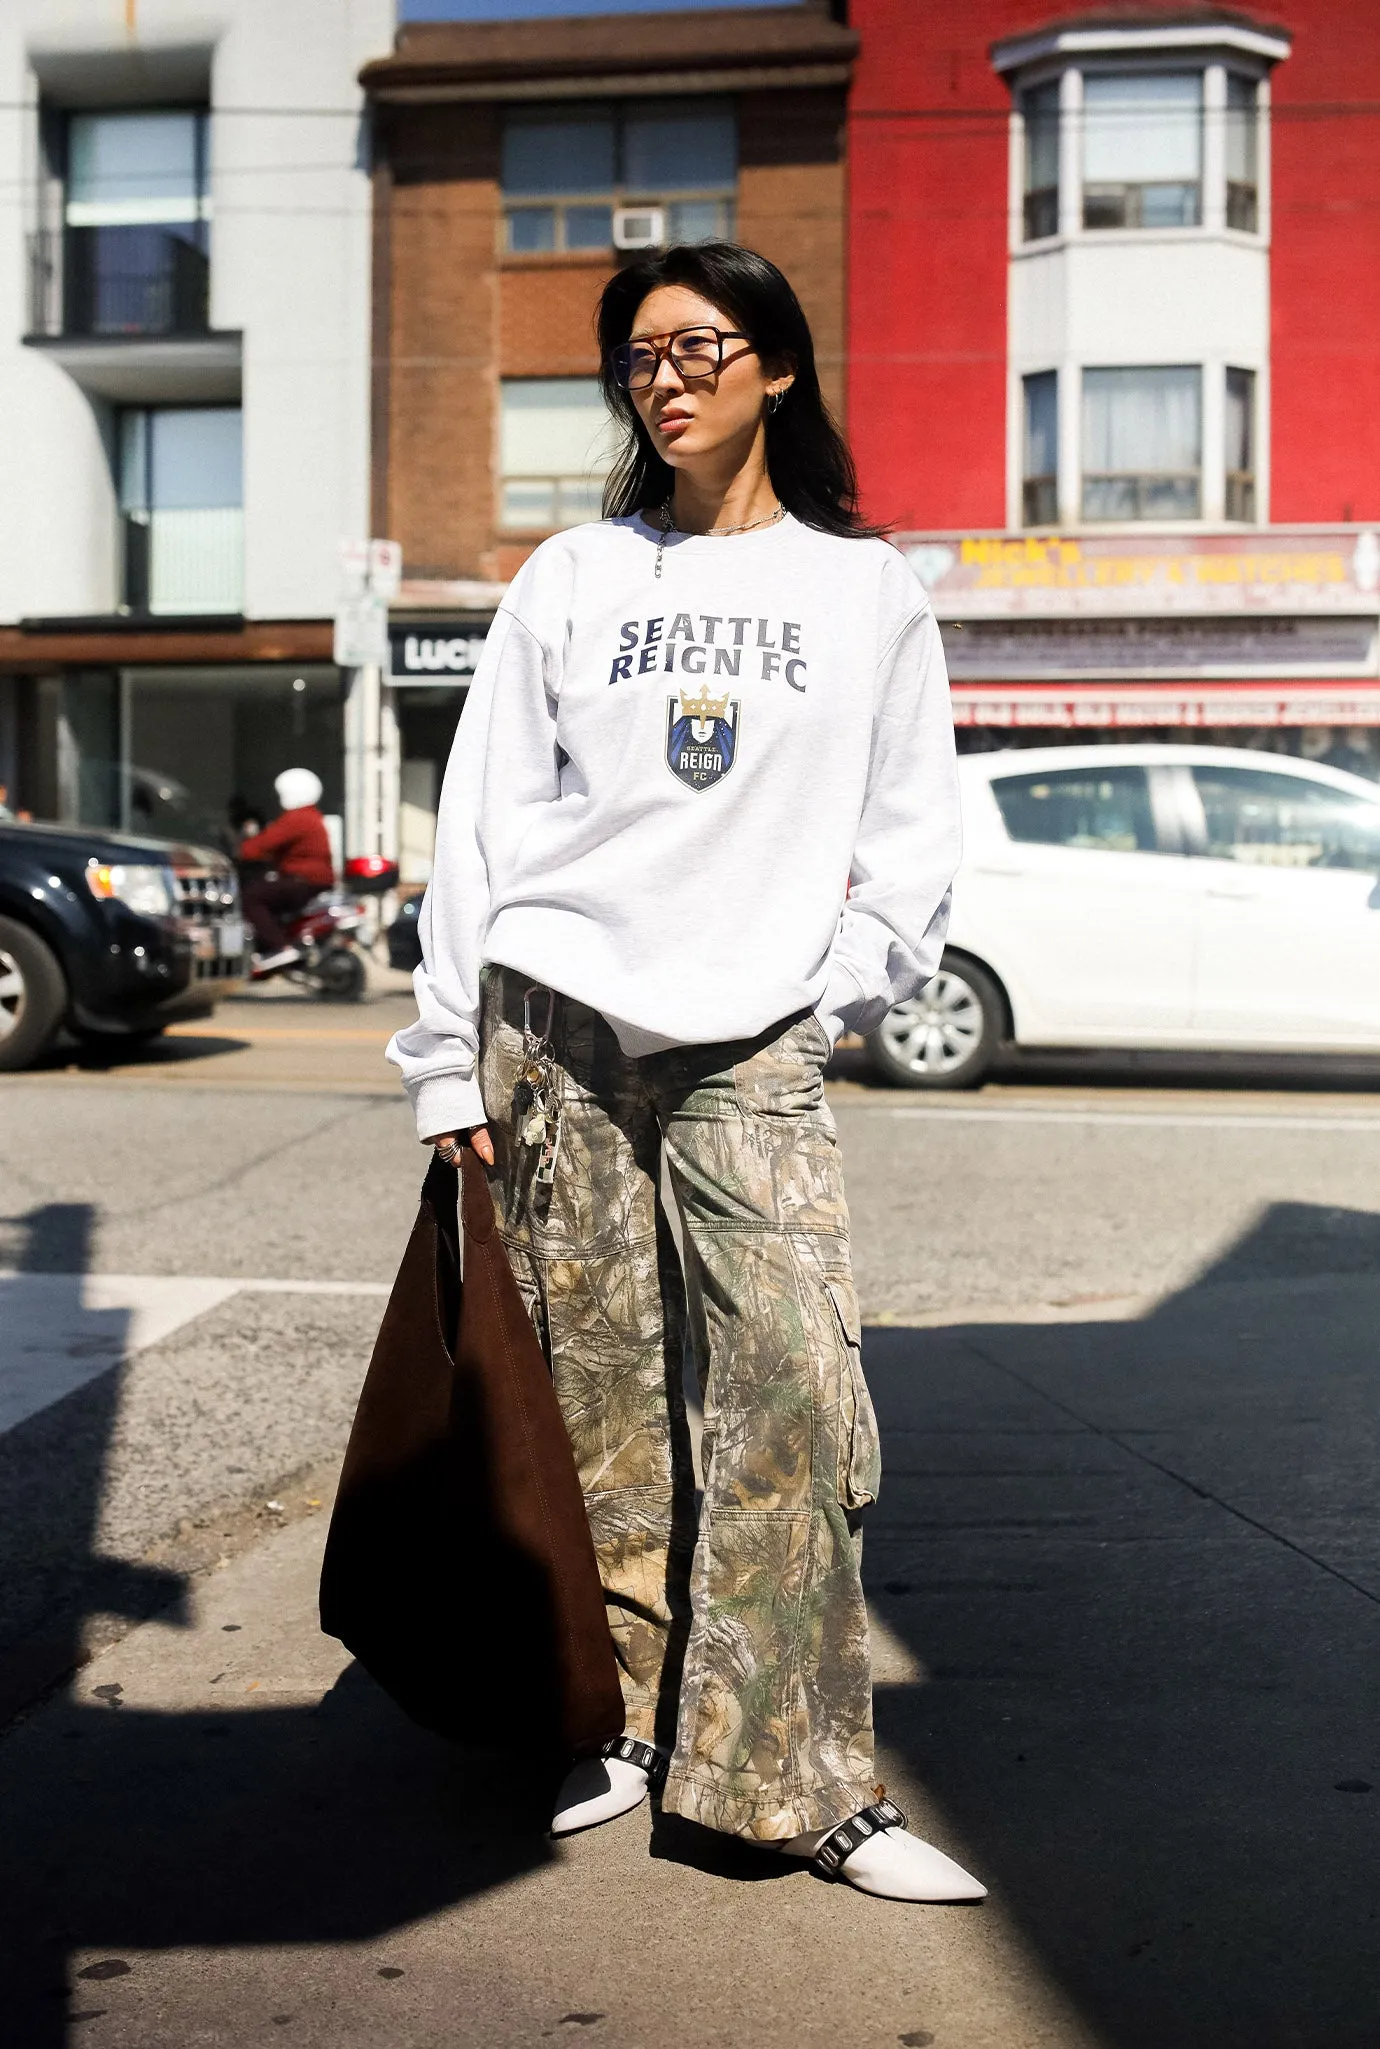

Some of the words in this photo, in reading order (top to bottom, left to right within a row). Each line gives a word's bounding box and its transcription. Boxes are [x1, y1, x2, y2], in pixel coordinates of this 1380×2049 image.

[620, 613, 801, 655] SEATTLE
[608, 643, 742, 686] REIGN
[761, 651, 807, 693] FC
[680, 752, 722, 772] REIGN
[693, 772, 707, 781] FC
